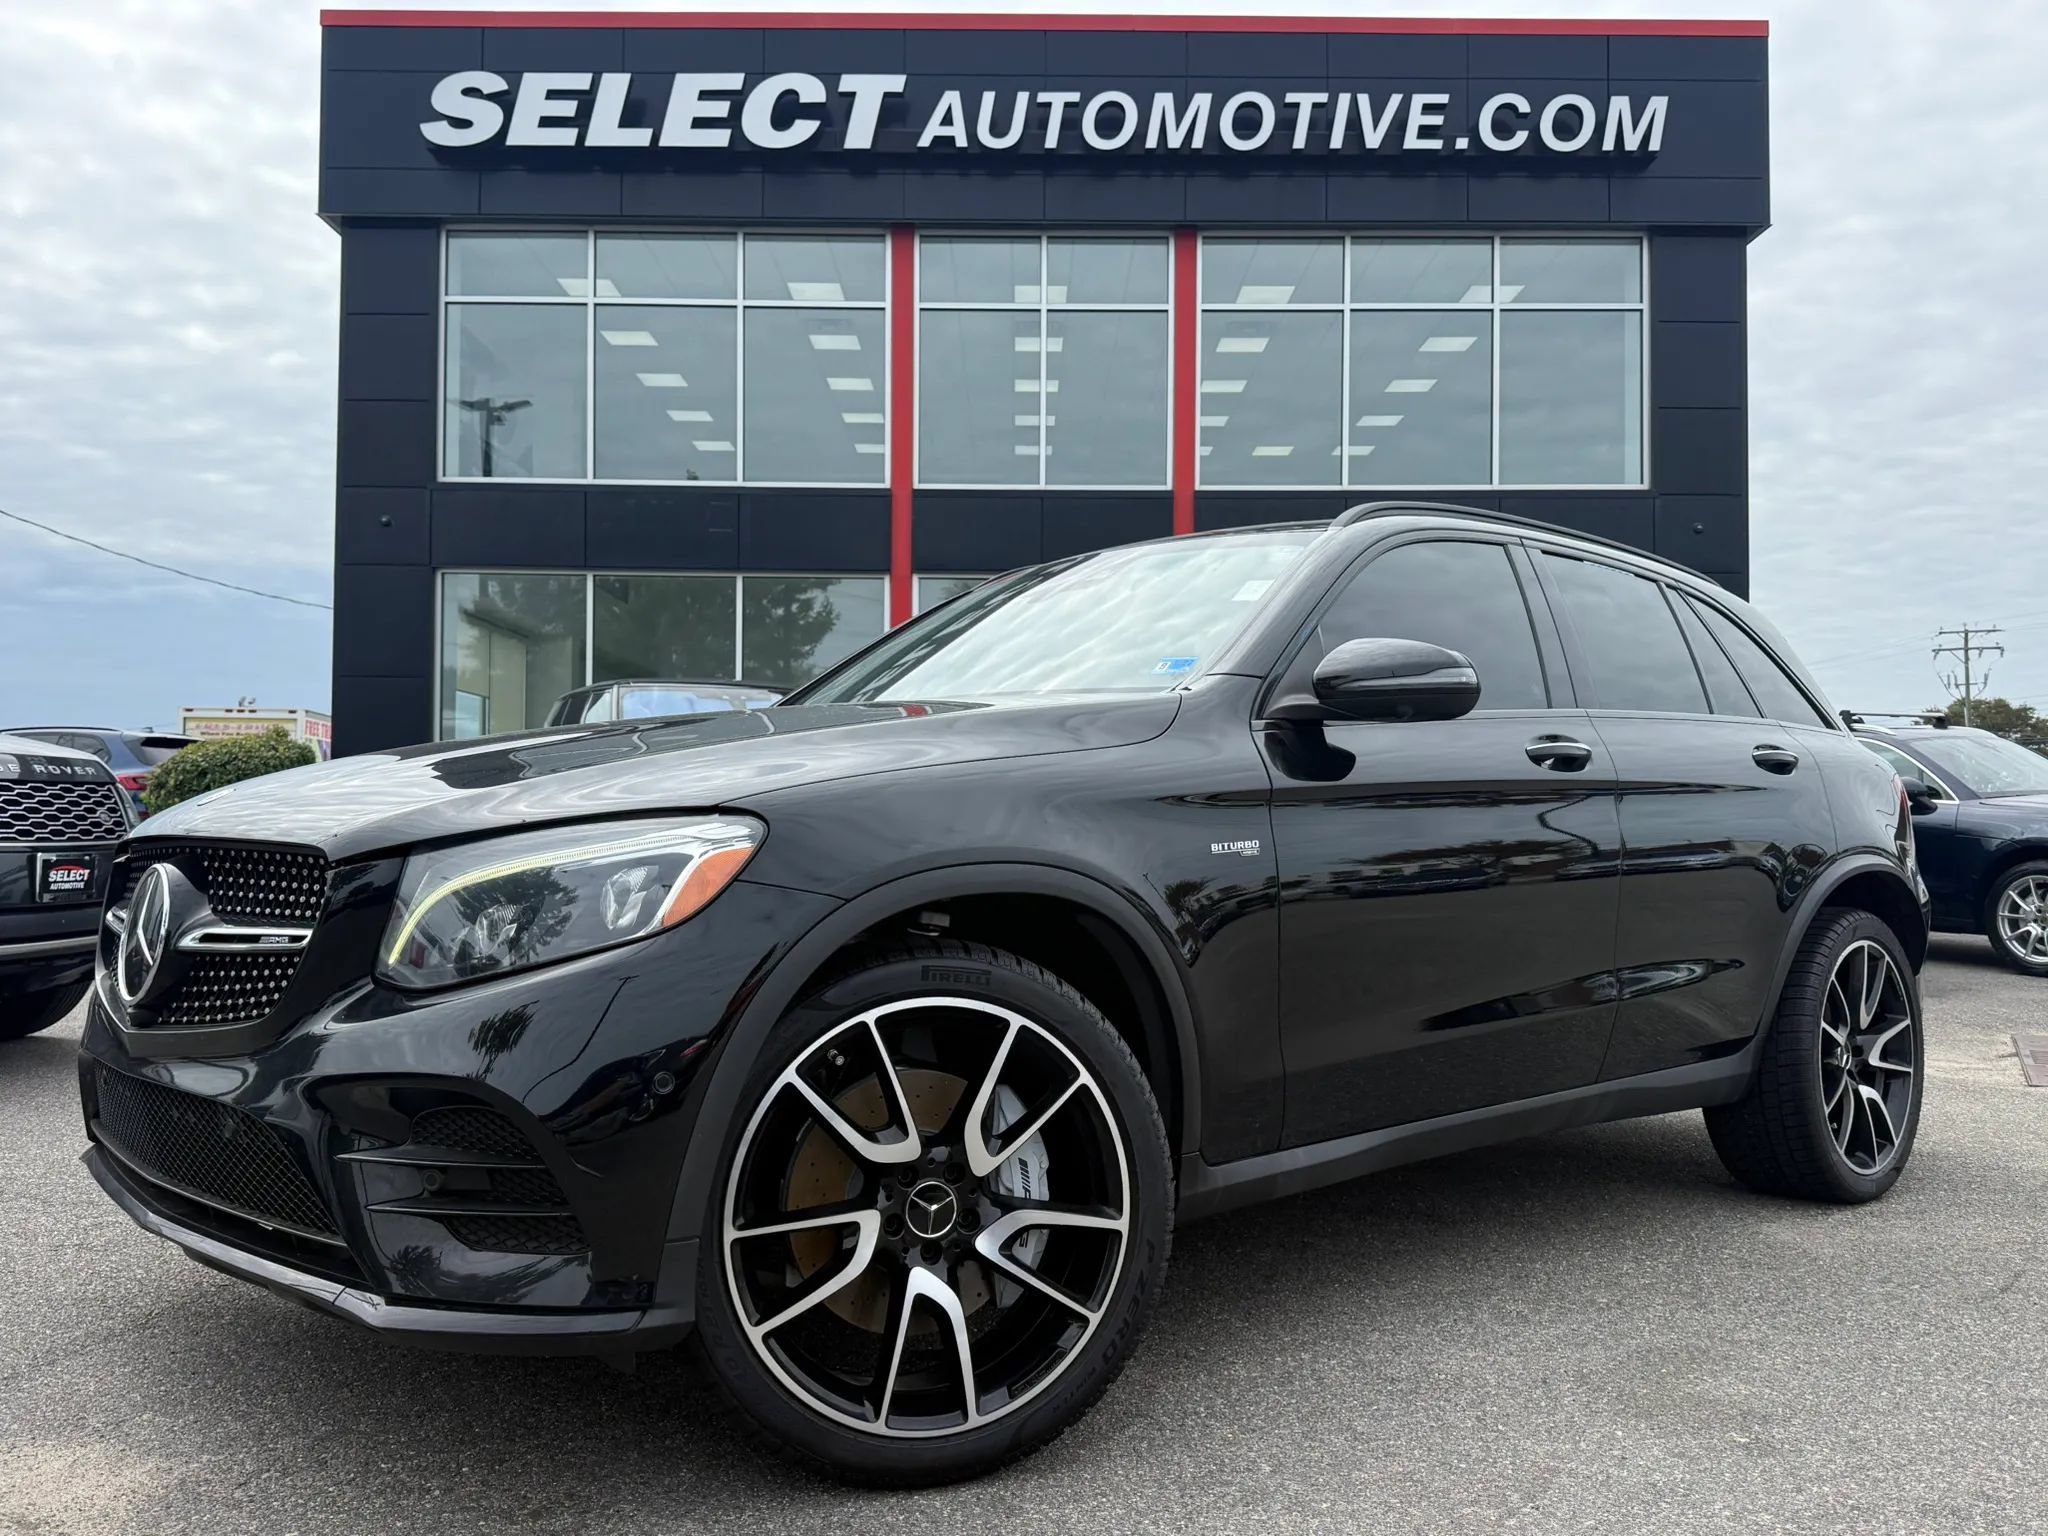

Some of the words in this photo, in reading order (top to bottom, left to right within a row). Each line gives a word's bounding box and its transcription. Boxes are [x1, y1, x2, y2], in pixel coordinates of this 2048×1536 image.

[420, 70, 907, 149] SELECT
[917, 89, 1669, 153] AUTOMOTIVE.COM
[305, 719, 320, 737] FREE
[33, 764, 97, 775] ROVER
[1210, 839, 1260, 852] BITURBO
[48, 869, 91, 882] SELECT
[49, 882, 85, 890] AUTOMOTIVE
[921, 965, 992, 986] PIRELLI
